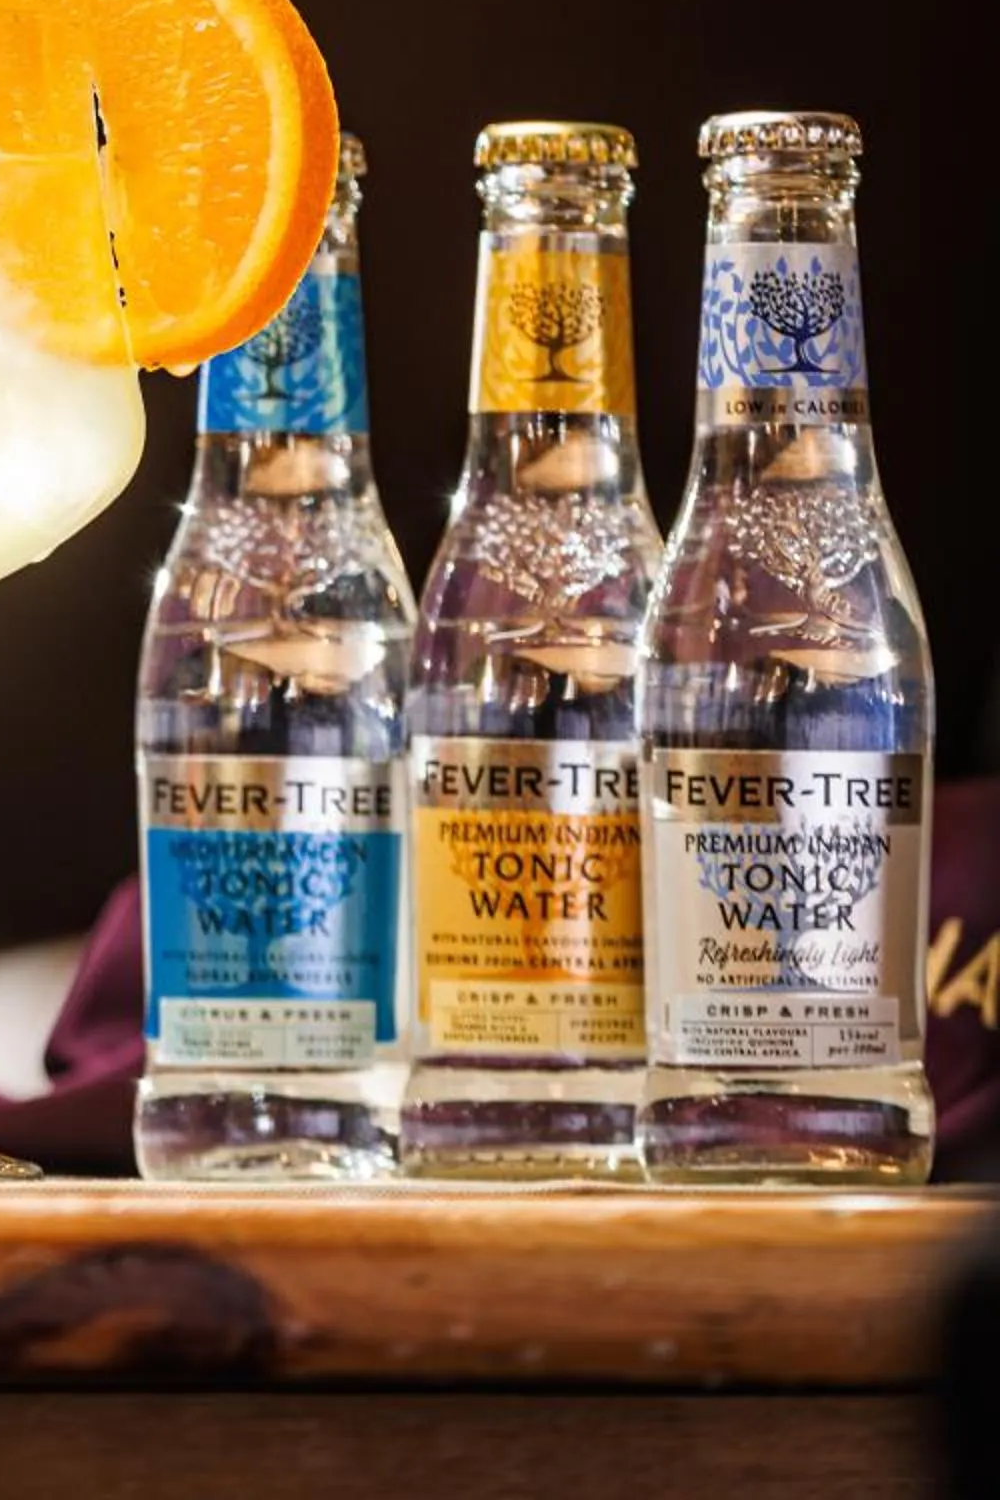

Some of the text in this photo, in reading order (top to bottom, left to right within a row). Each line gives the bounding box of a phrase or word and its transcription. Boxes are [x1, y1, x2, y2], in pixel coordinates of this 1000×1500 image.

[725, 401, 763, 414] LOW
[423, 761, 640, 799] FEVER-TRE
[666, 770, 914, 808] FEVER-TREE
[440, 821, 547, 845] PREMIUM
[685, 833, 797, 854] PREMIUM
[476, 852, 604, 883] TONIC
[722, 863, 853, 893] TONIC
[469, 891, 608, 921] WATER
[719, 902, 856, 931] WATER
[697, 974, 714, 984] NO
[707, 1005, 870, 1018] CRISP & FRESH
